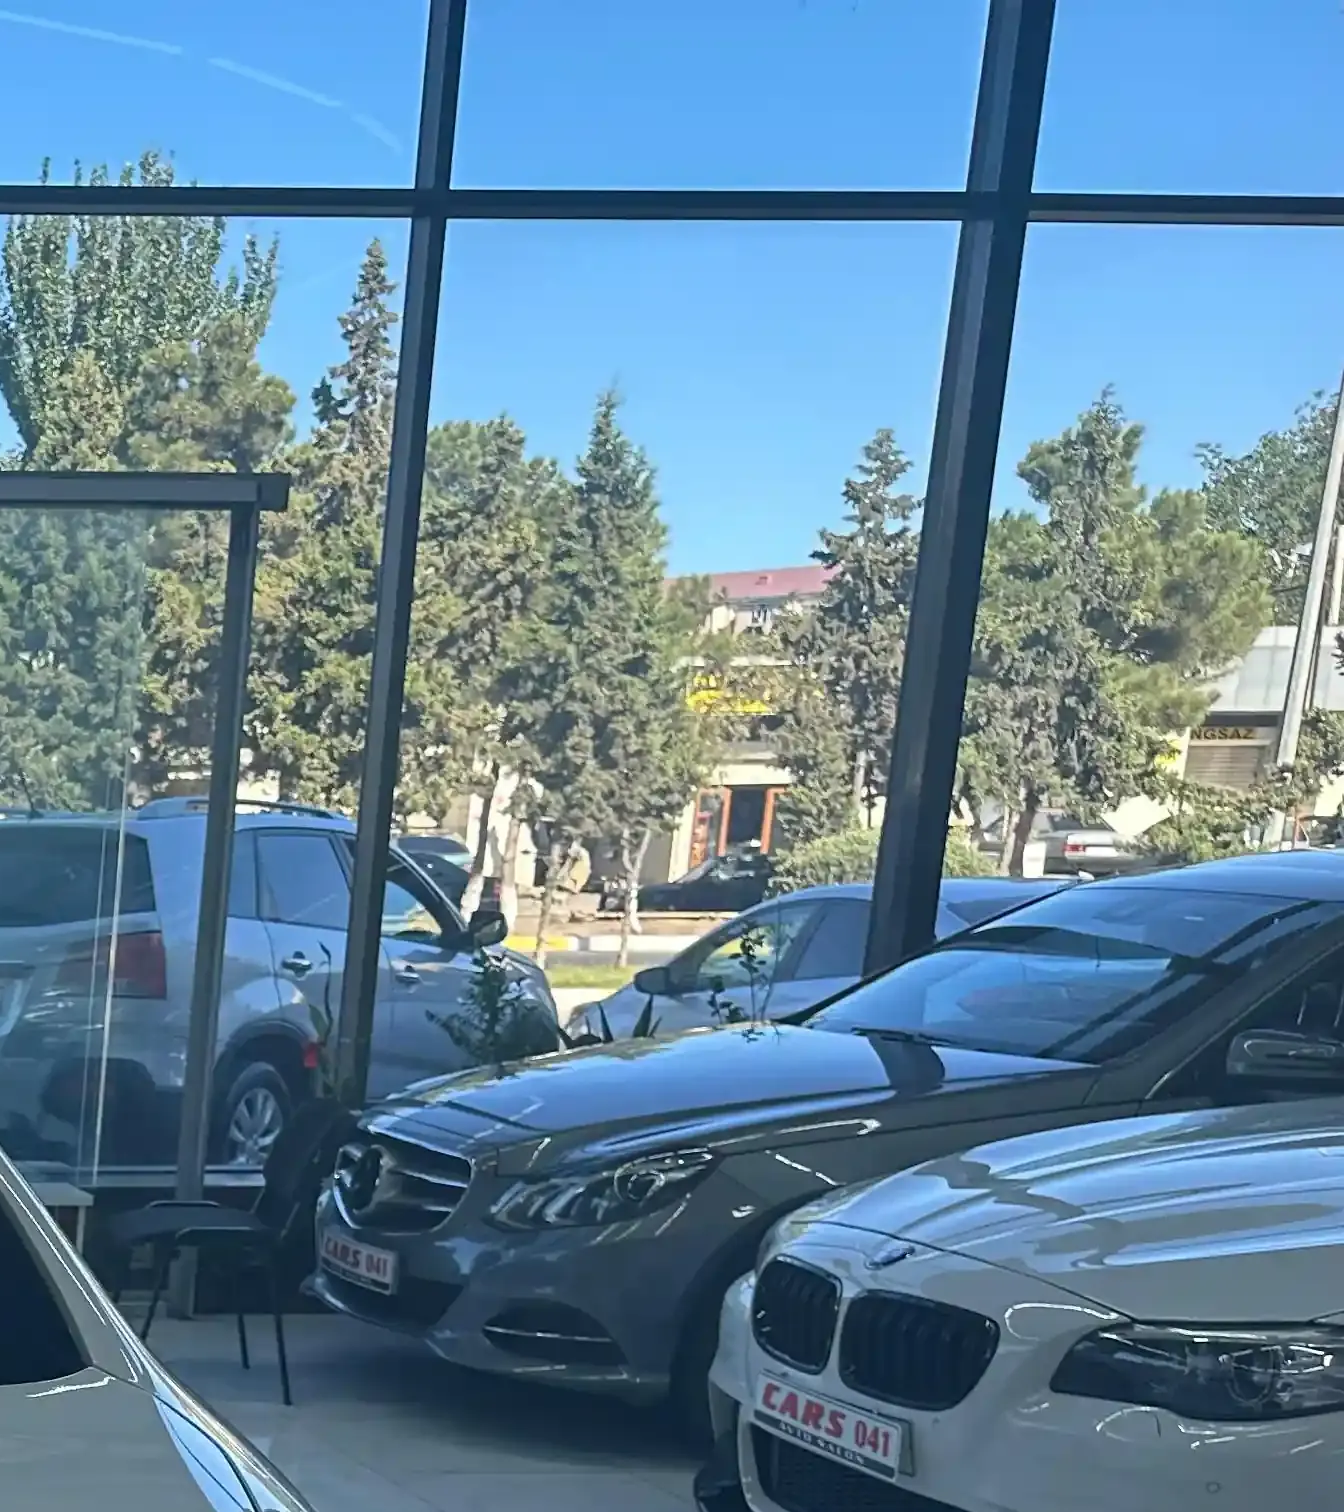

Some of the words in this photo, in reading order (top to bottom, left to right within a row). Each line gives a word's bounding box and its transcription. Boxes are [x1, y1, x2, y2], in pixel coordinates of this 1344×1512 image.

[1191, 726, 1255, 740] NGSAZ
[761, 1381, 847, 1439] CARS
[853, 1419, 891, 1458] 041
